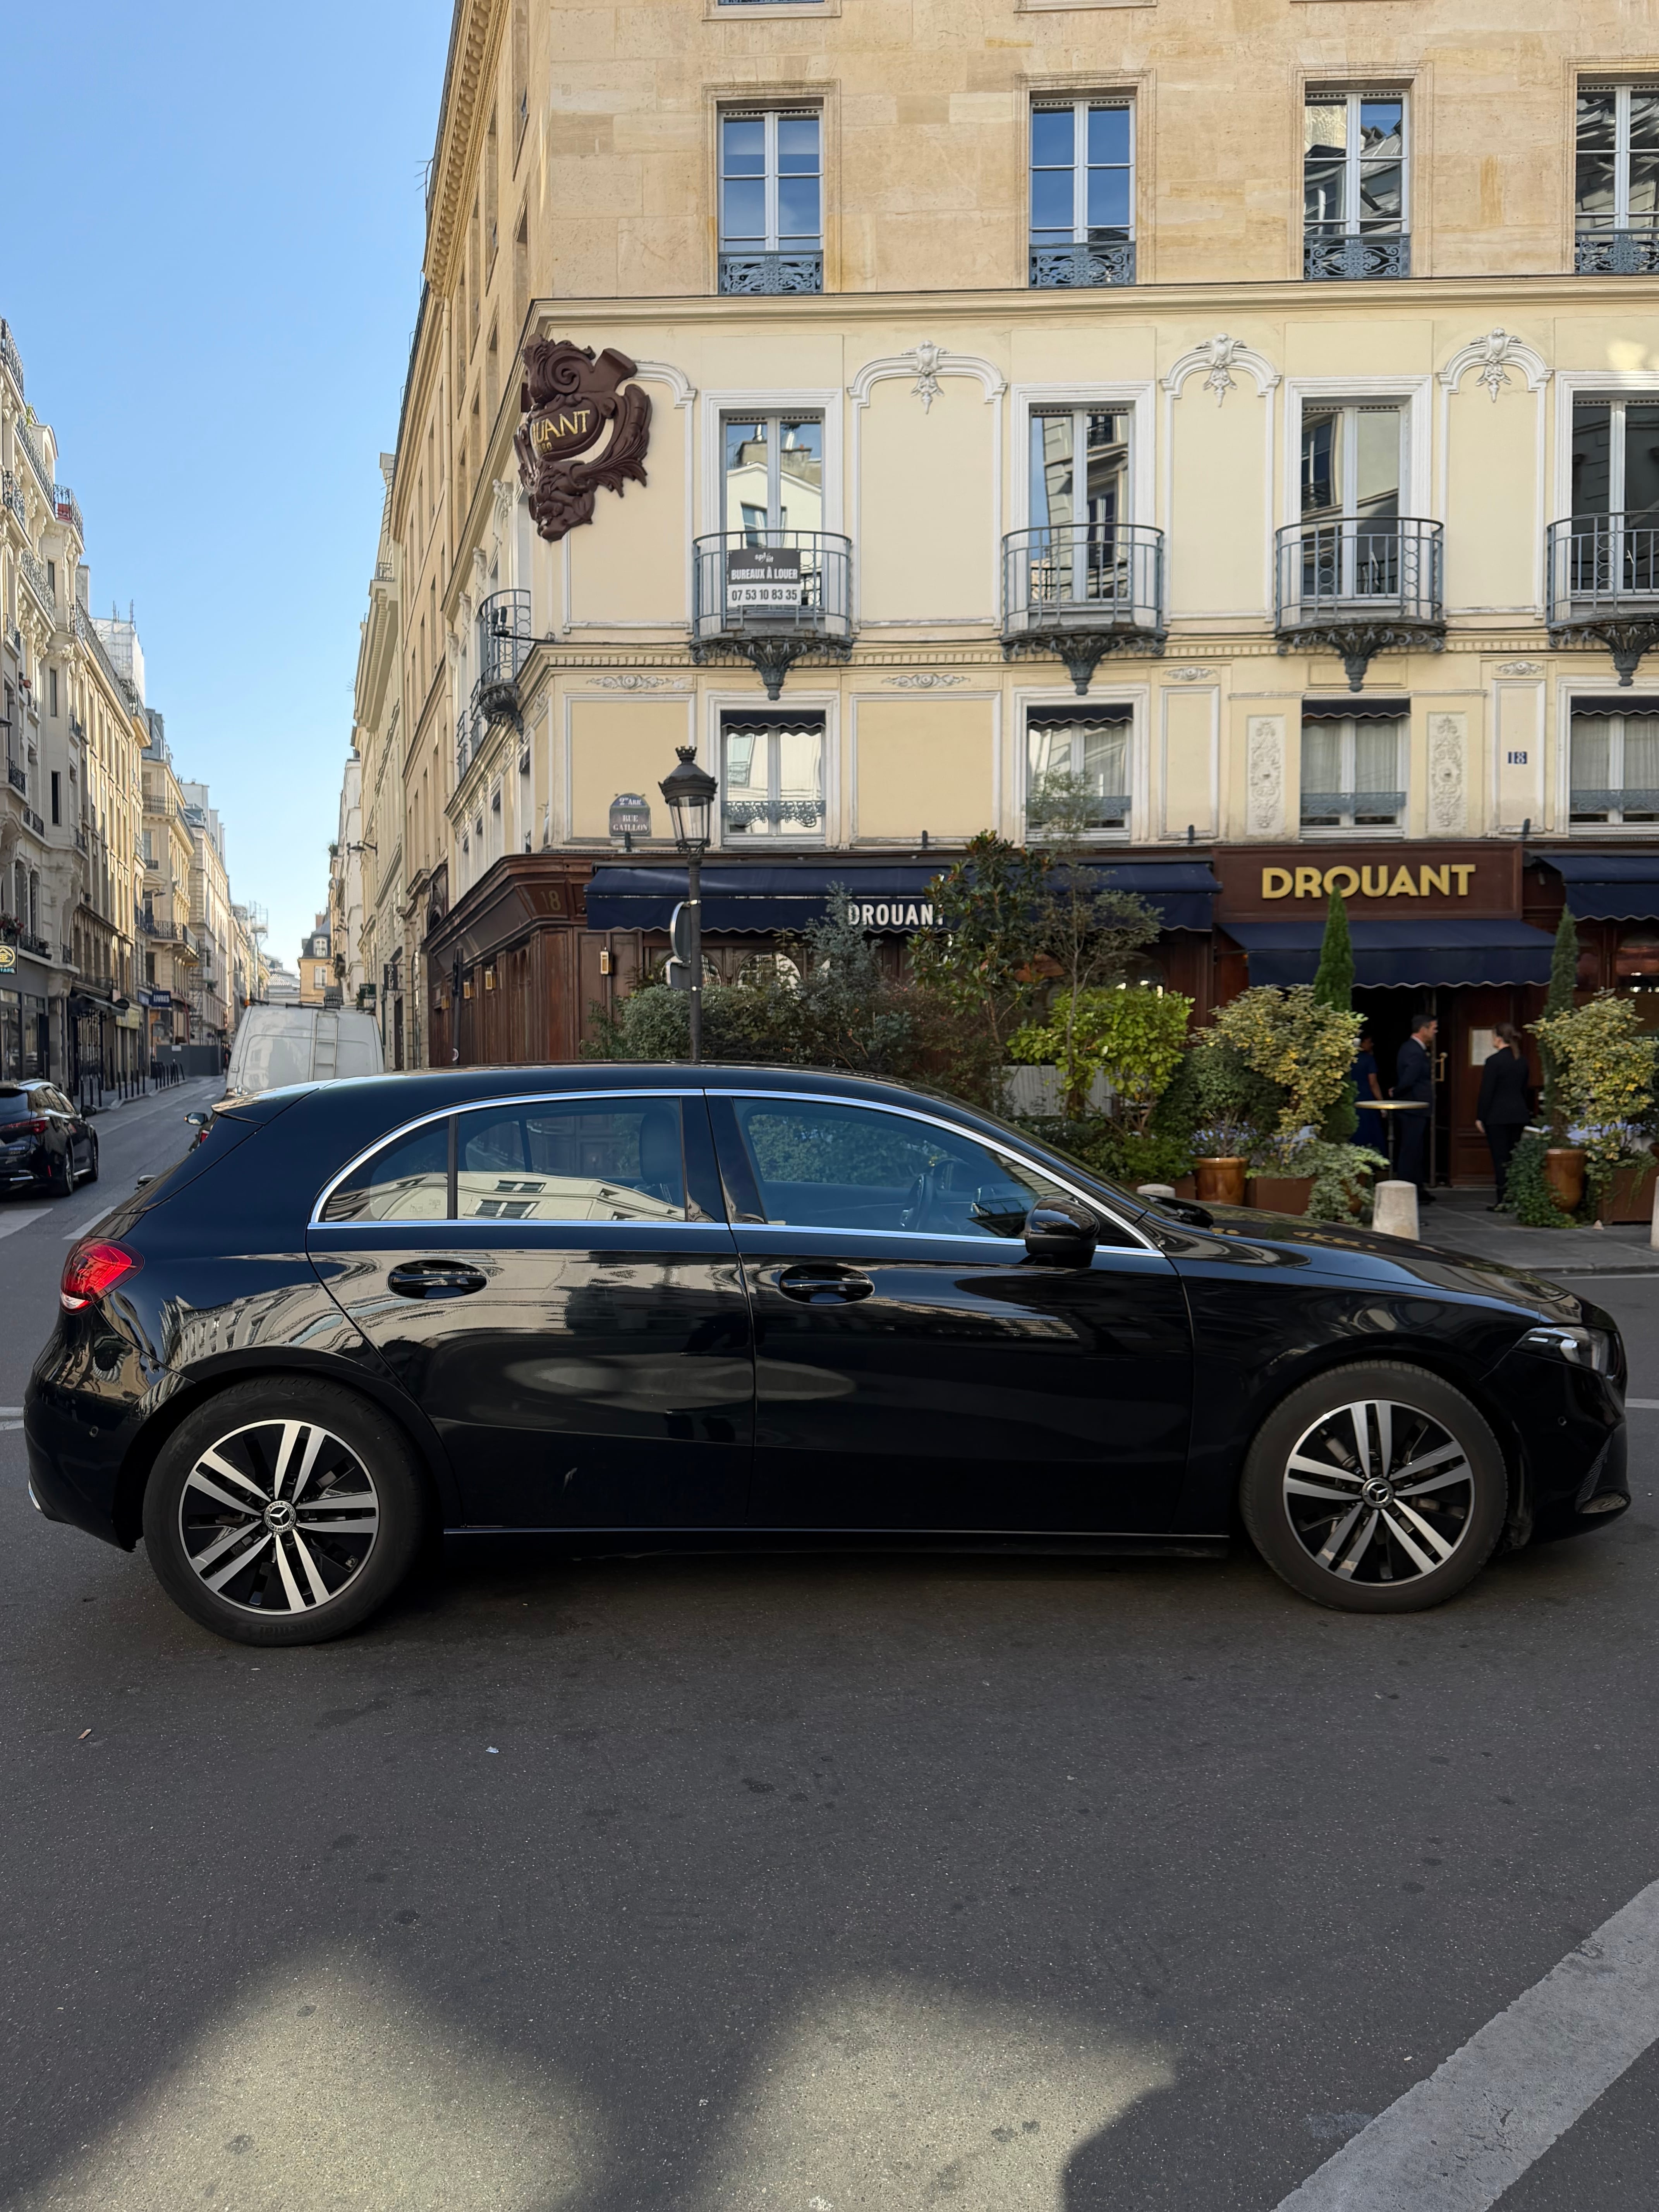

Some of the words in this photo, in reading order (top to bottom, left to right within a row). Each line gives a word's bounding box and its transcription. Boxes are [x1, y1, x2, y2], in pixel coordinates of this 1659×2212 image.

[731, 568, 765, 580] BUREAUX
[766, 566, 773, 579] À
[774, 568, 798, 579] LOUER
[732, 589, 743, 601] 07
[745, 589, 756, 600] 53
[759, 589, 769, 600] 10
[772, 589, 783, 600] 83
[786, 589, 797, 600] 35
[1510, 751, 1525, 764] 18
[1262, 864, 1476, 899] DROUANT
[540, 890, 561, 911] 18
[153, 994, 170, 1003] LIVRES
